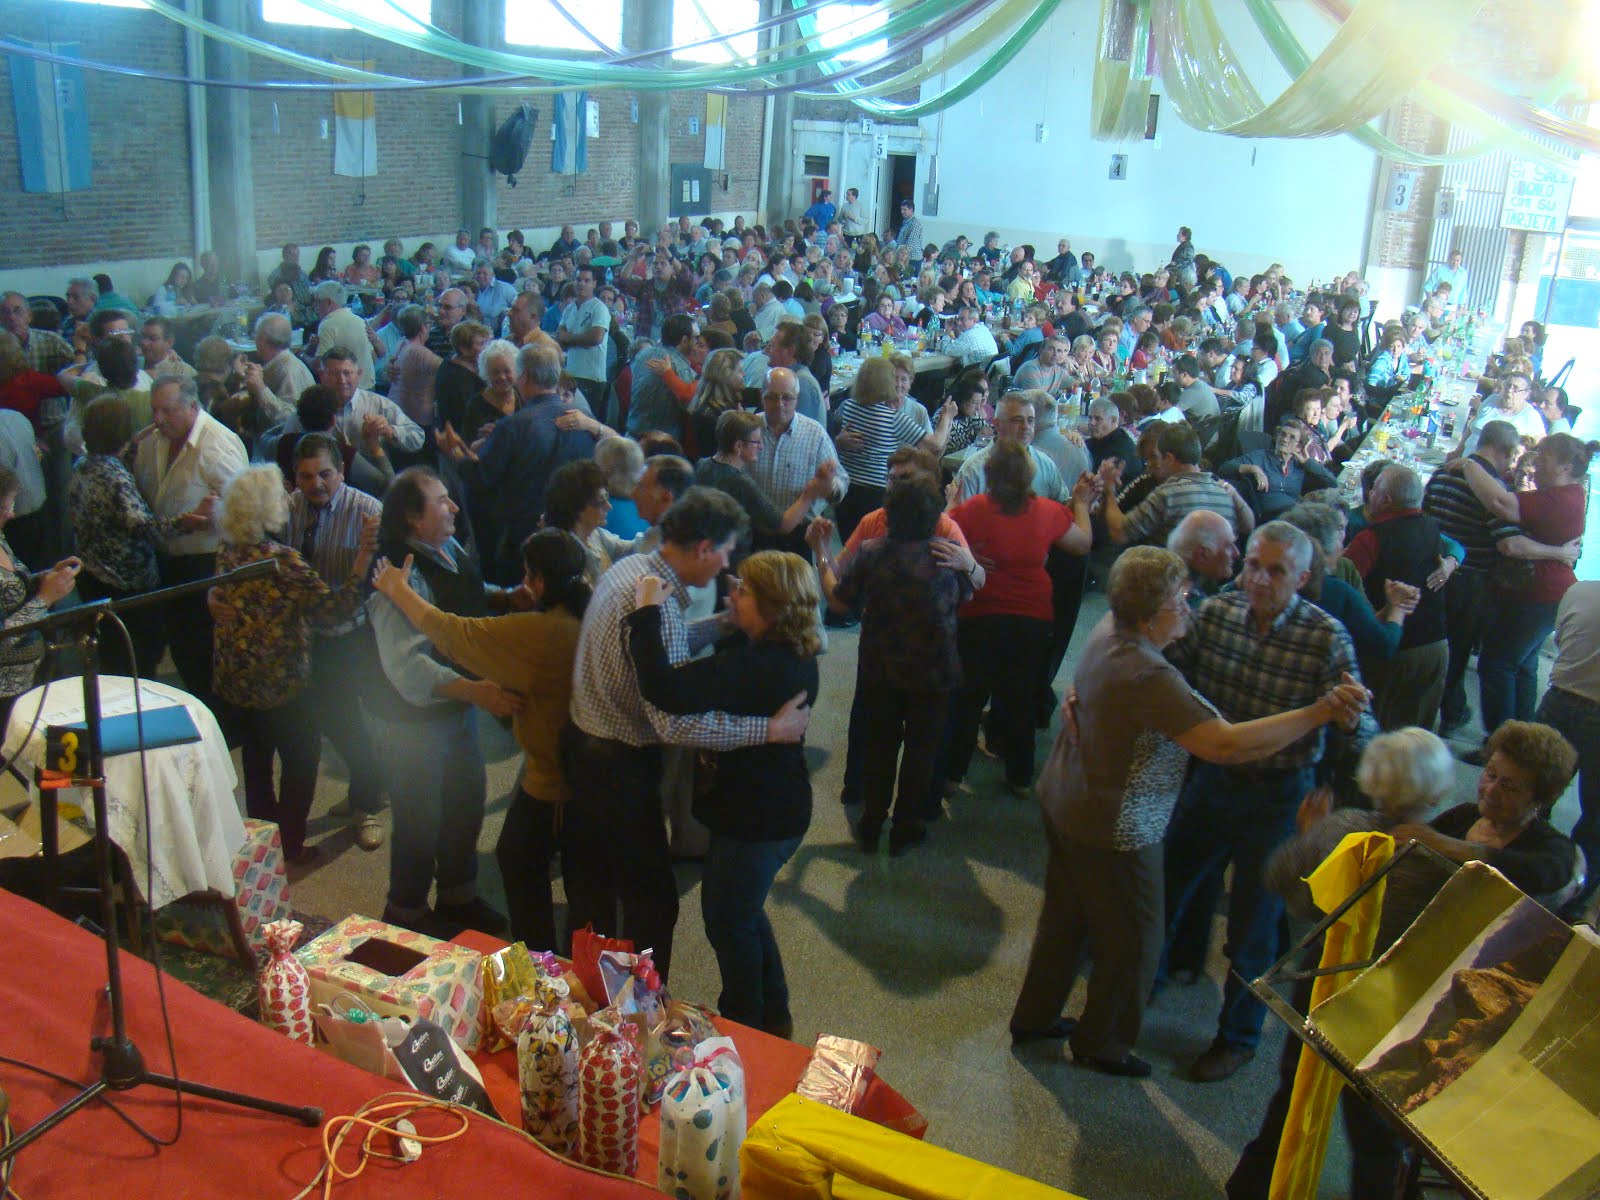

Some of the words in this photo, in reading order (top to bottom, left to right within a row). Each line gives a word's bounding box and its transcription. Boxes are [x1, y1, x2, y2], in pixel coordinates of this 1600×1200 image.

[876, 143, 883, 155] 5
[1113, 163, 1121, 177] 4
[1394, 184, 1407, 206] 3
[1440, 200, 1449, 215] 3
[1537, 198, 1557, 212] SU
[1503, 208, 1557, 232] TARJETA
[58, 732, 79, 772] 3
